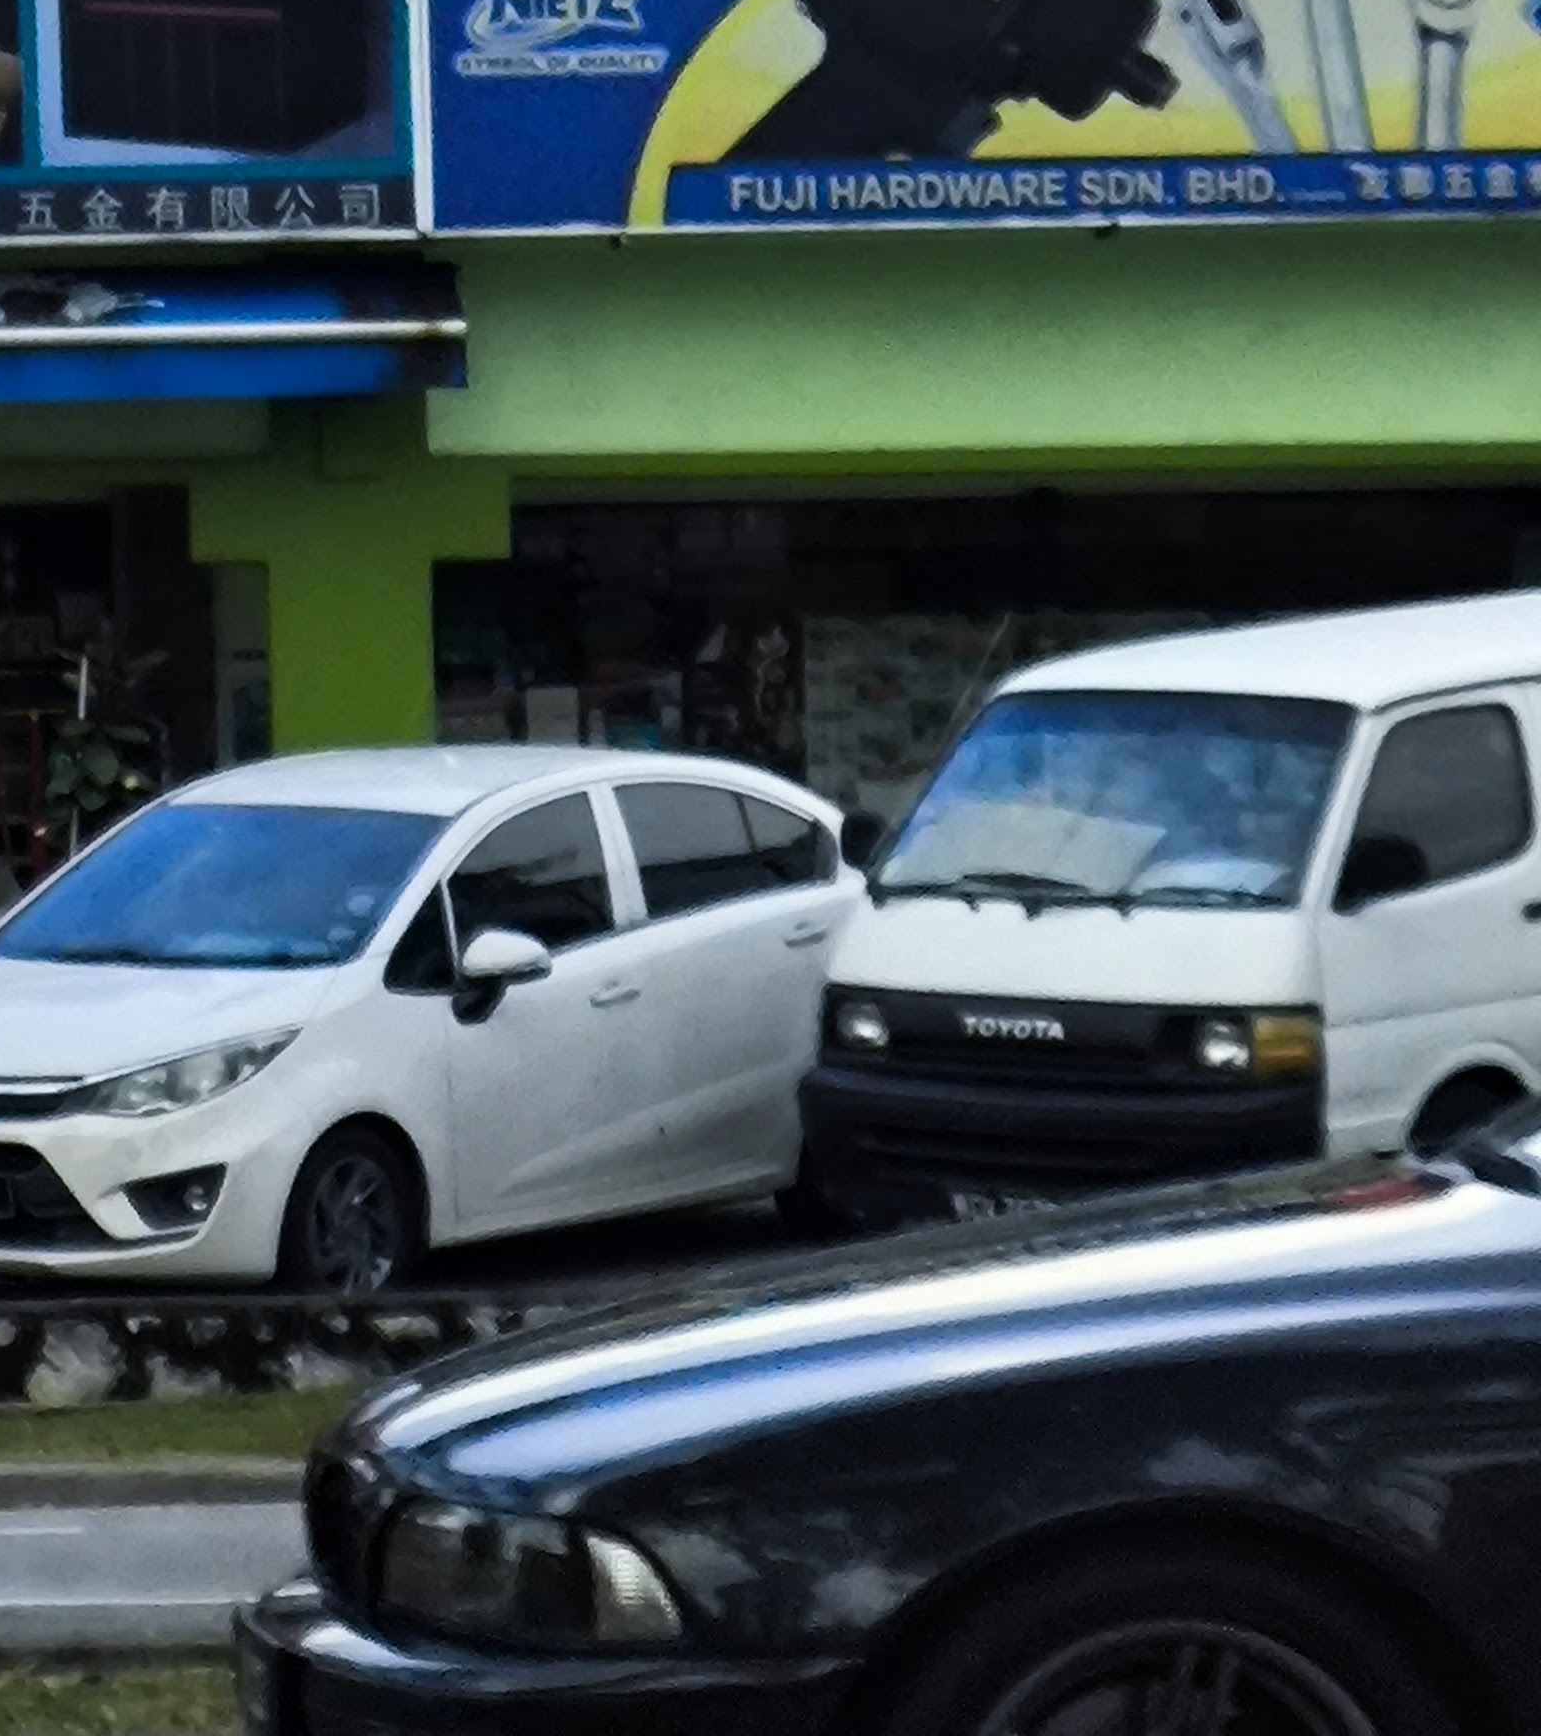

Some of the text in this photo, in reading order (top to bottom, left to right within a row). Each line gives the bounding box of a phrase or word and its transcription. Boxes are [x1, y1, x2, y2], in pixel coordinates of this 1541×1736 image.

[729, 174, 816, 212] FUJI
[828, 169, 1066, 211] HARDWARE
[1079, 168, 1175, 208] SDN.
[1187, 165, 1284, 205] BHD.
[960, 1014, 1065, 1041] TOYOTA
